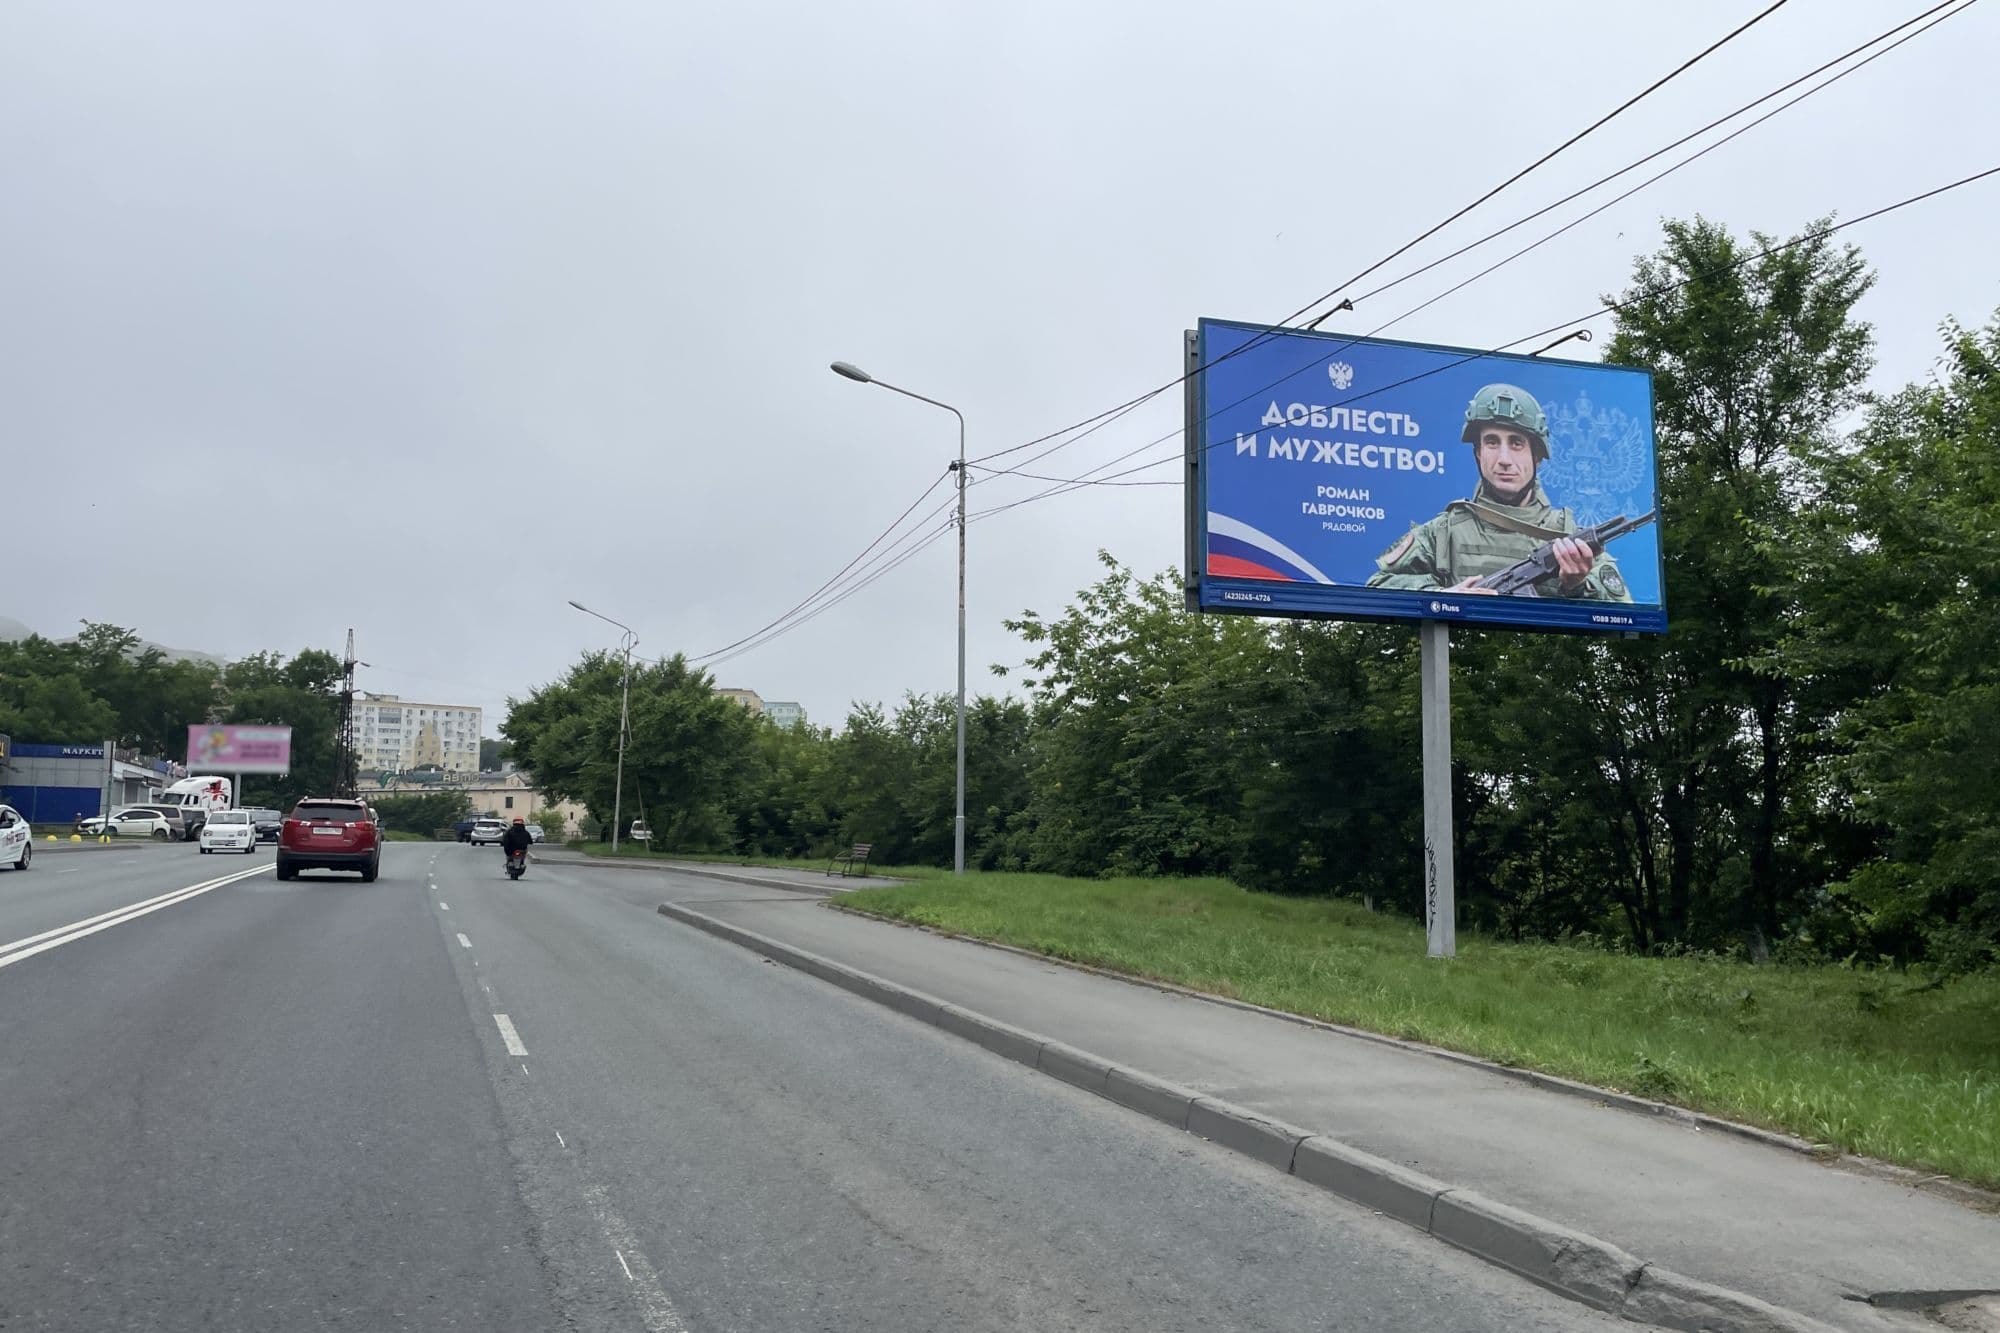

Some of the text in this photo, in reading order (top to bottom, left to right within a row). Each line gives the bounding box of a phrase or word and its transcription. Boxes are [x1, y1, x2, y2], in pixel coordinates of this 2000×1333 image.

[1262, 401, 1420, 437] ДОБЛЕСТЬ
[1236, 432, 1445, 475] И МУЖЕСТВО!
[1317, 485, 1370, 501] РОМАН
[1302, 502, 1385, 520] ГАВРОЧКОВ
[1322, 521, 1366, 533] РЯДОВОЙ
[1441, 603, 1460, 612] Russ
[62, 748, 104, 756] МАРКЕТ
